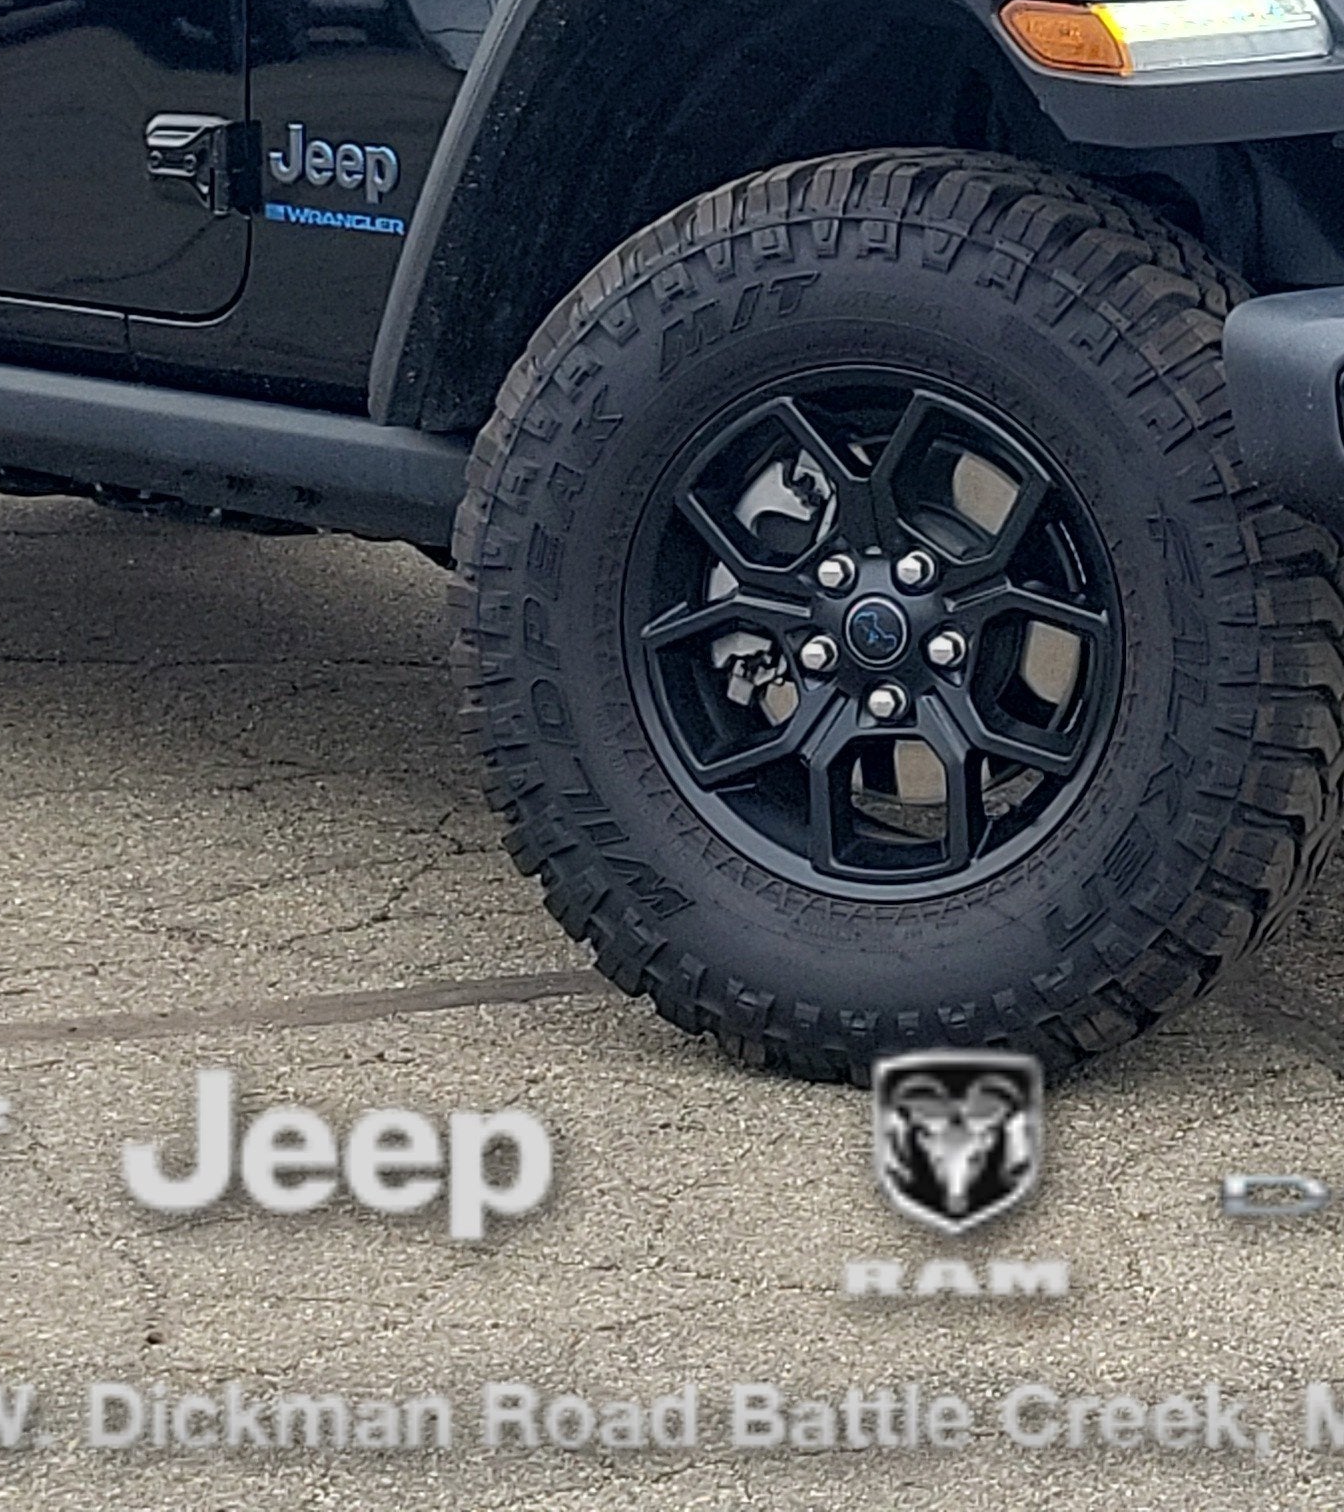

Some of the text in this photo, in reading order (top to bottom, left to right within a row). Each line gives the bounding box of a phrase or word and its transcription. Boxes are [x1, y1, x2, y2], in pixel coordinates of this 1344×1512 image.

[268, 123, 398, 204] Jeep
[285, 203, 405, 236] WRANGLER
[658, 270, 820, 382] M/T
